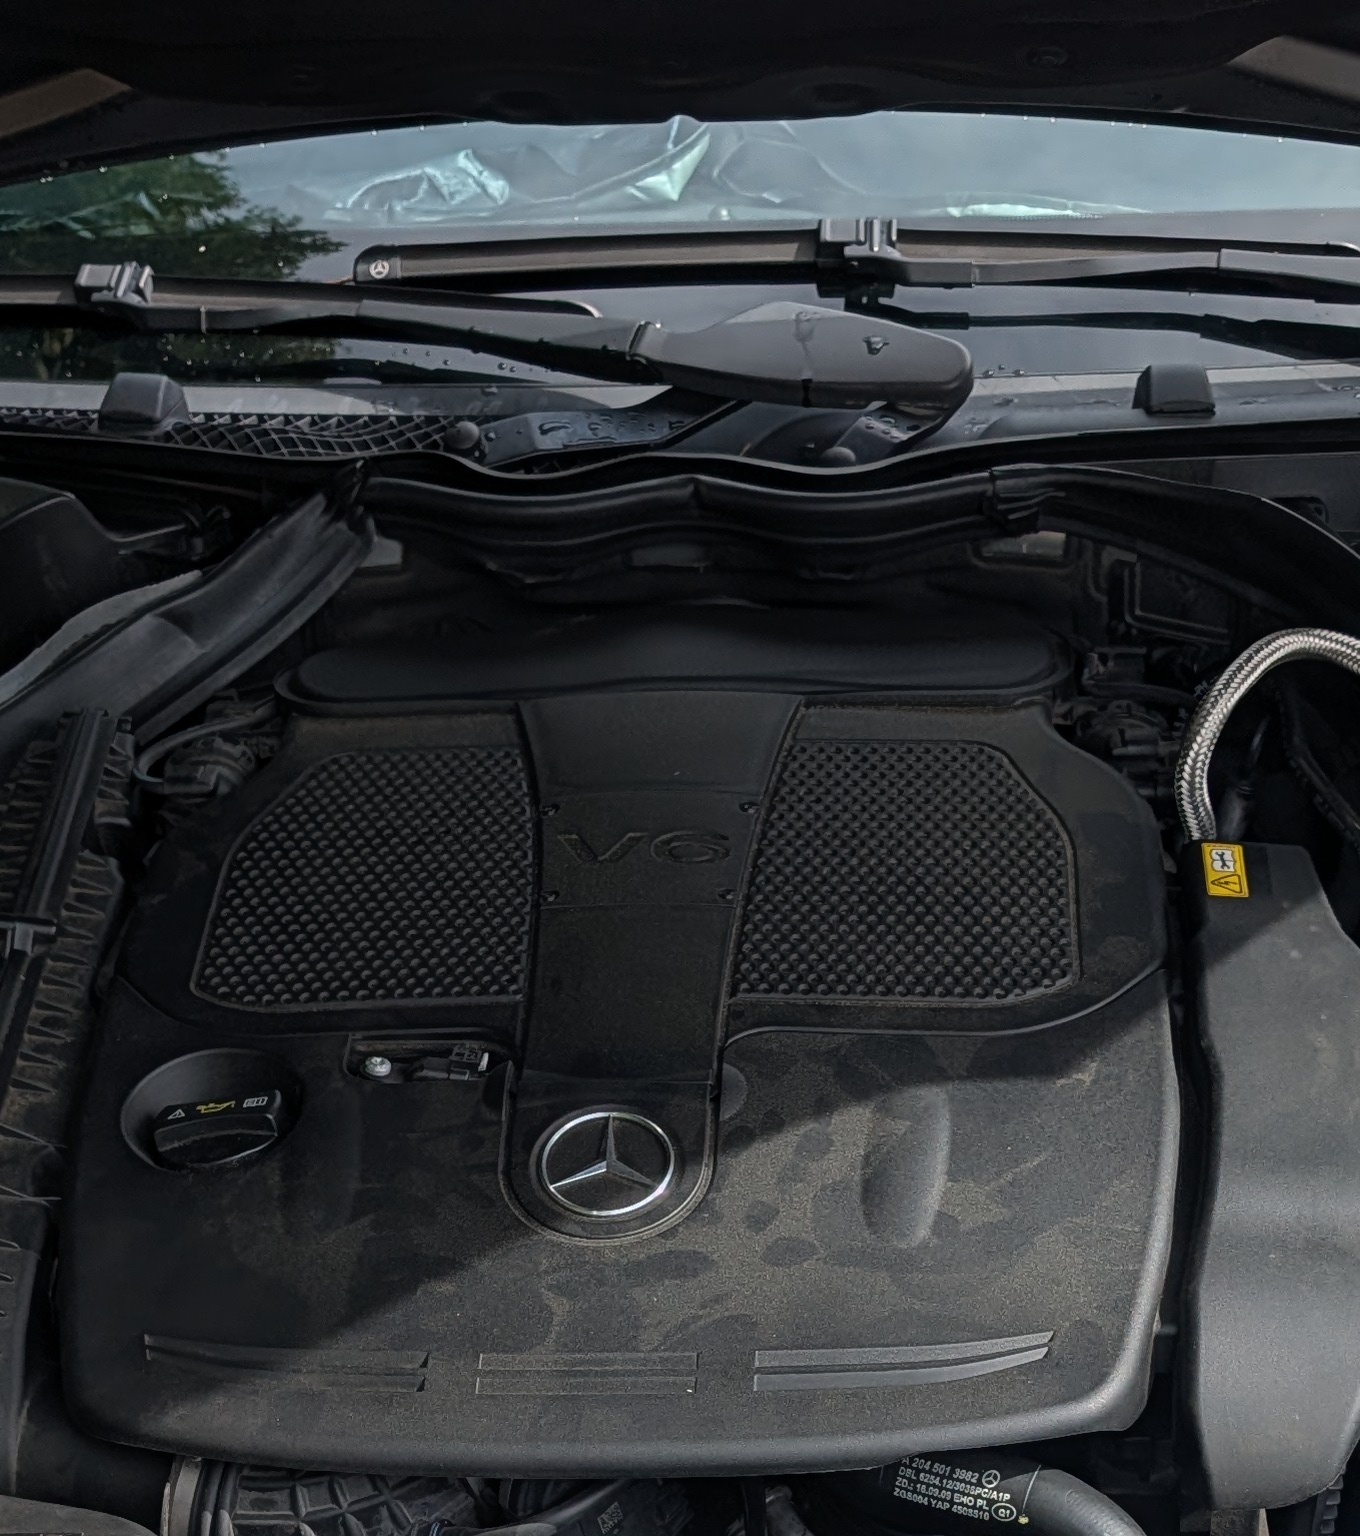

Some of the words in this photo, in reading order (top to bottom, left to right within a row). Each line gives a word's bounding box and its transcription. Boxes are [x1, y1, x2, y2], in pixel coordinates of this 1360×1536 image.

[557, 831, 731, 864] V6
[898, 1467, 917, 1479] DBL
[912, 1457, 931, 1470] 204
[932, 1462, 952, 1476] 501
[952, 1468, 980, 1483] 3982
[930, 1498, 950, 1511] YAP
[953, 1492, 975, 1506] EHO
[976, 1499, 990, 1511] PL
[998, 1508, 1011, 1518] Q1
